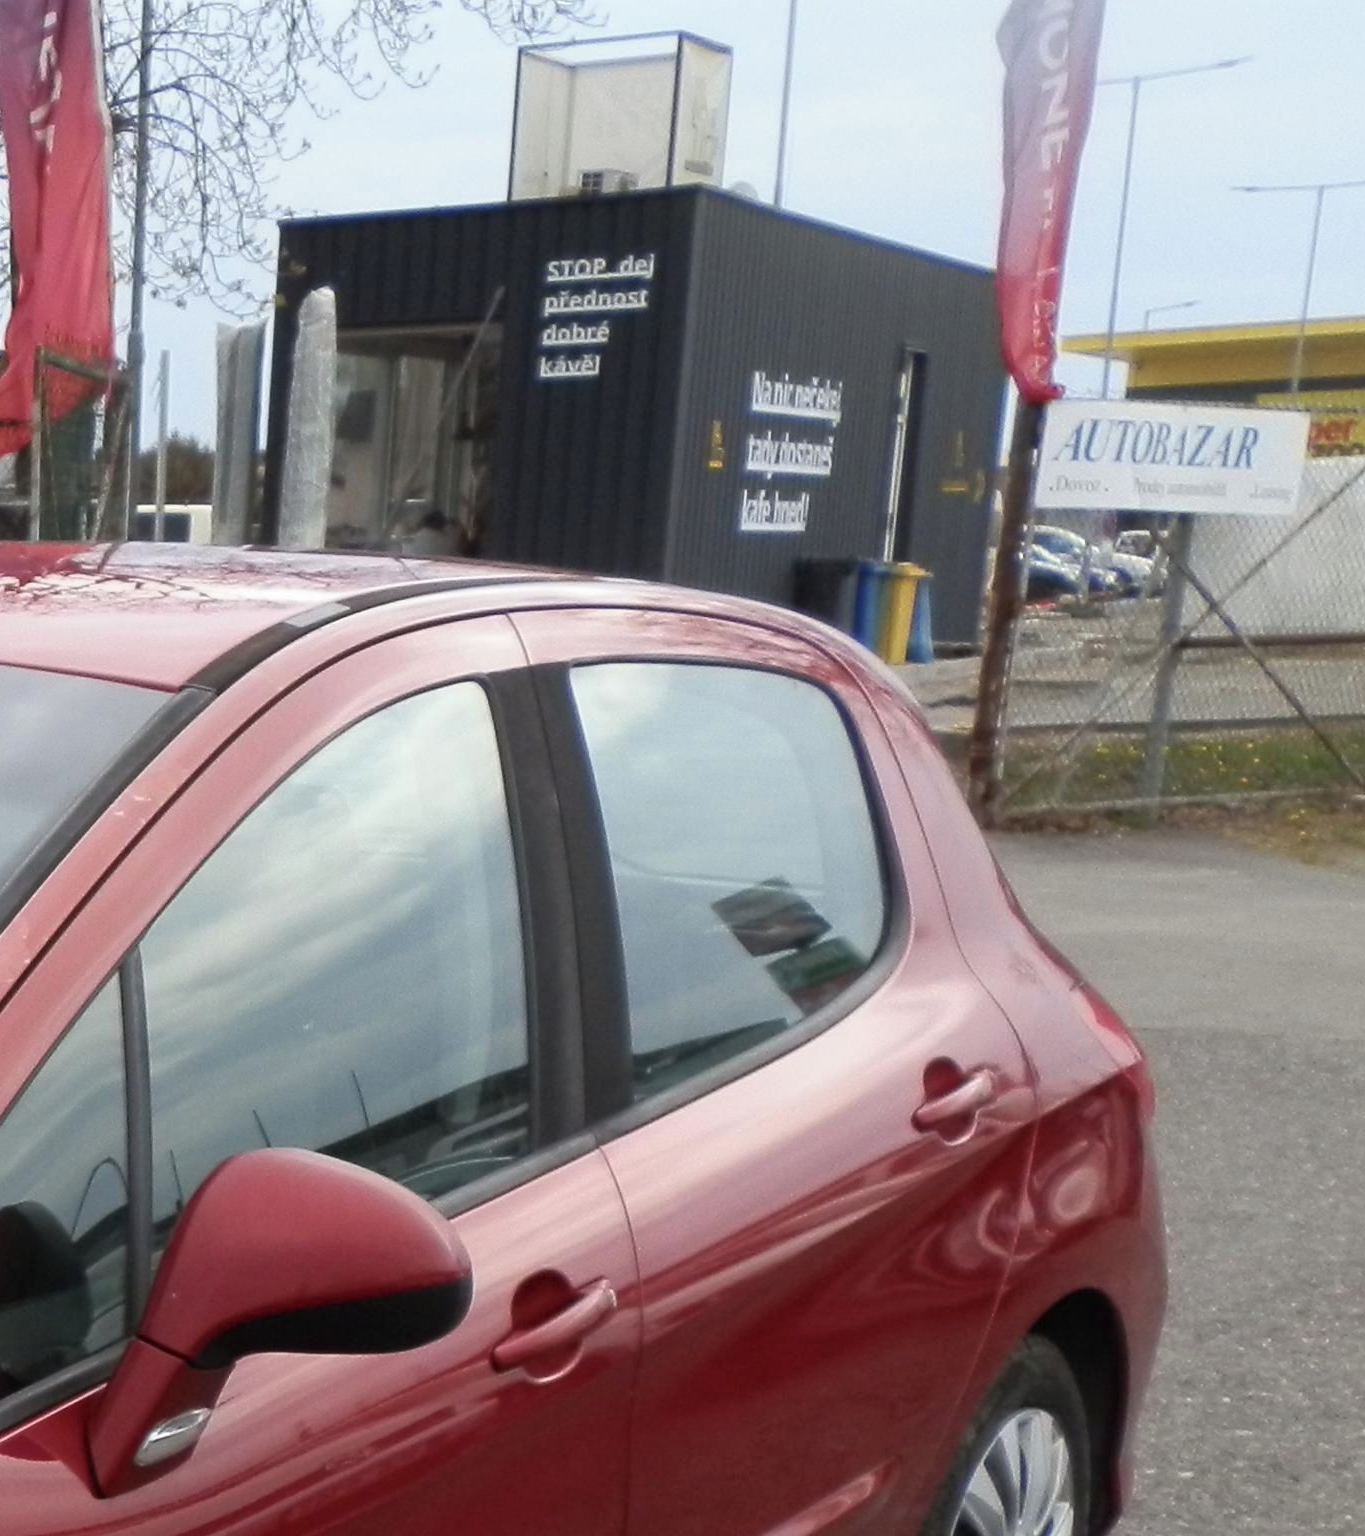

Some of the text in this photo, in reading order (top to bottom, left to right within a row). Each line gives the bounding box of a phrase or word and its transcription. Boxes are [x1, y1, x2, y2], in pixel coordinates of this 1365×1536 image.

[619, 253, 655, 279] dej
[544, 289, 649, 317] přednost
[542, 320, 610, 344] dobré
[1054, 418, 1259, 469] AUTOBAZAR
